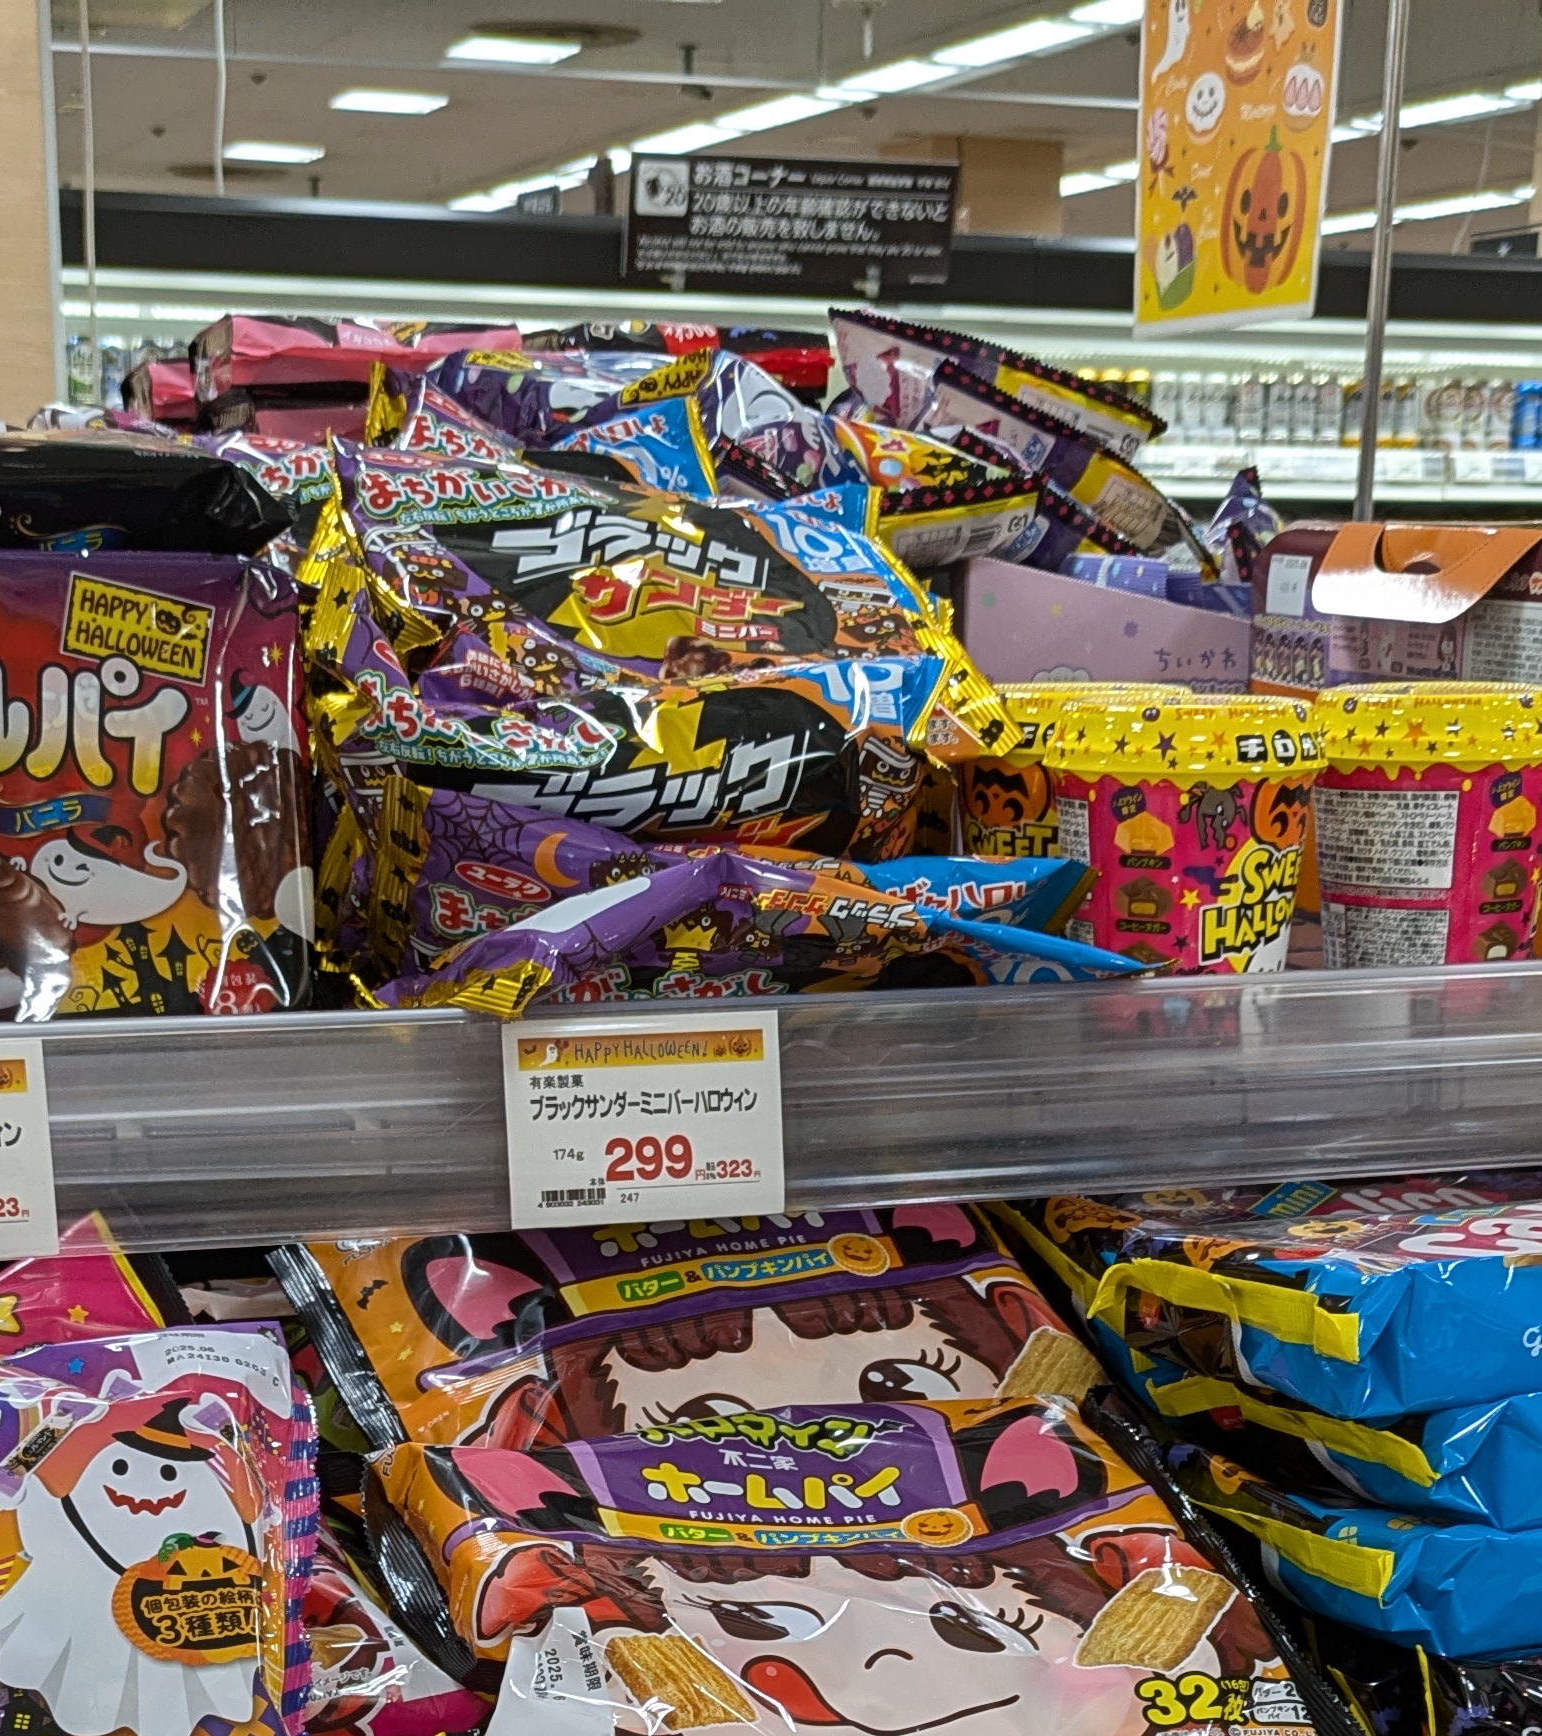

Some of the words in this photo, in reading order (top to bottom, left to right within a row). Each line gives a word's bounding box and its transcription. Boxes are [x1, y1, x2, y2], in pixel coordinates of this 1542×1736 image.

[492, 508, 761, 586] ブラック
[80, 588, 150, 626] HAPPY
[74, 618, 198, 670] HALLOWEEN
[12, 798, 85, 832] バニラ
[457, 861, 553, 902] ユーラク
[574, 1043, 619, 1064] HAPPY
[623, 1039, 708, 1059] HALLOWEEN!
[529, 1074, 584, 1089] 有楽製菓
[553, 1150, 584, 1161] 174g
[620, 1193, 639, 1203] 247
[640, 1247, 708, 1267] FUJIYA
[717, 1238, 771, 1253] HOME
[779, 1234, 807, 1246] PIE
[641, 1462, 902, 1510] ホームパイ
[689, 1510, 760, 1524] FUJIYA
[773, 1514, 833, 1525] HOME
[844, 1513, 877, 1524] PIE
